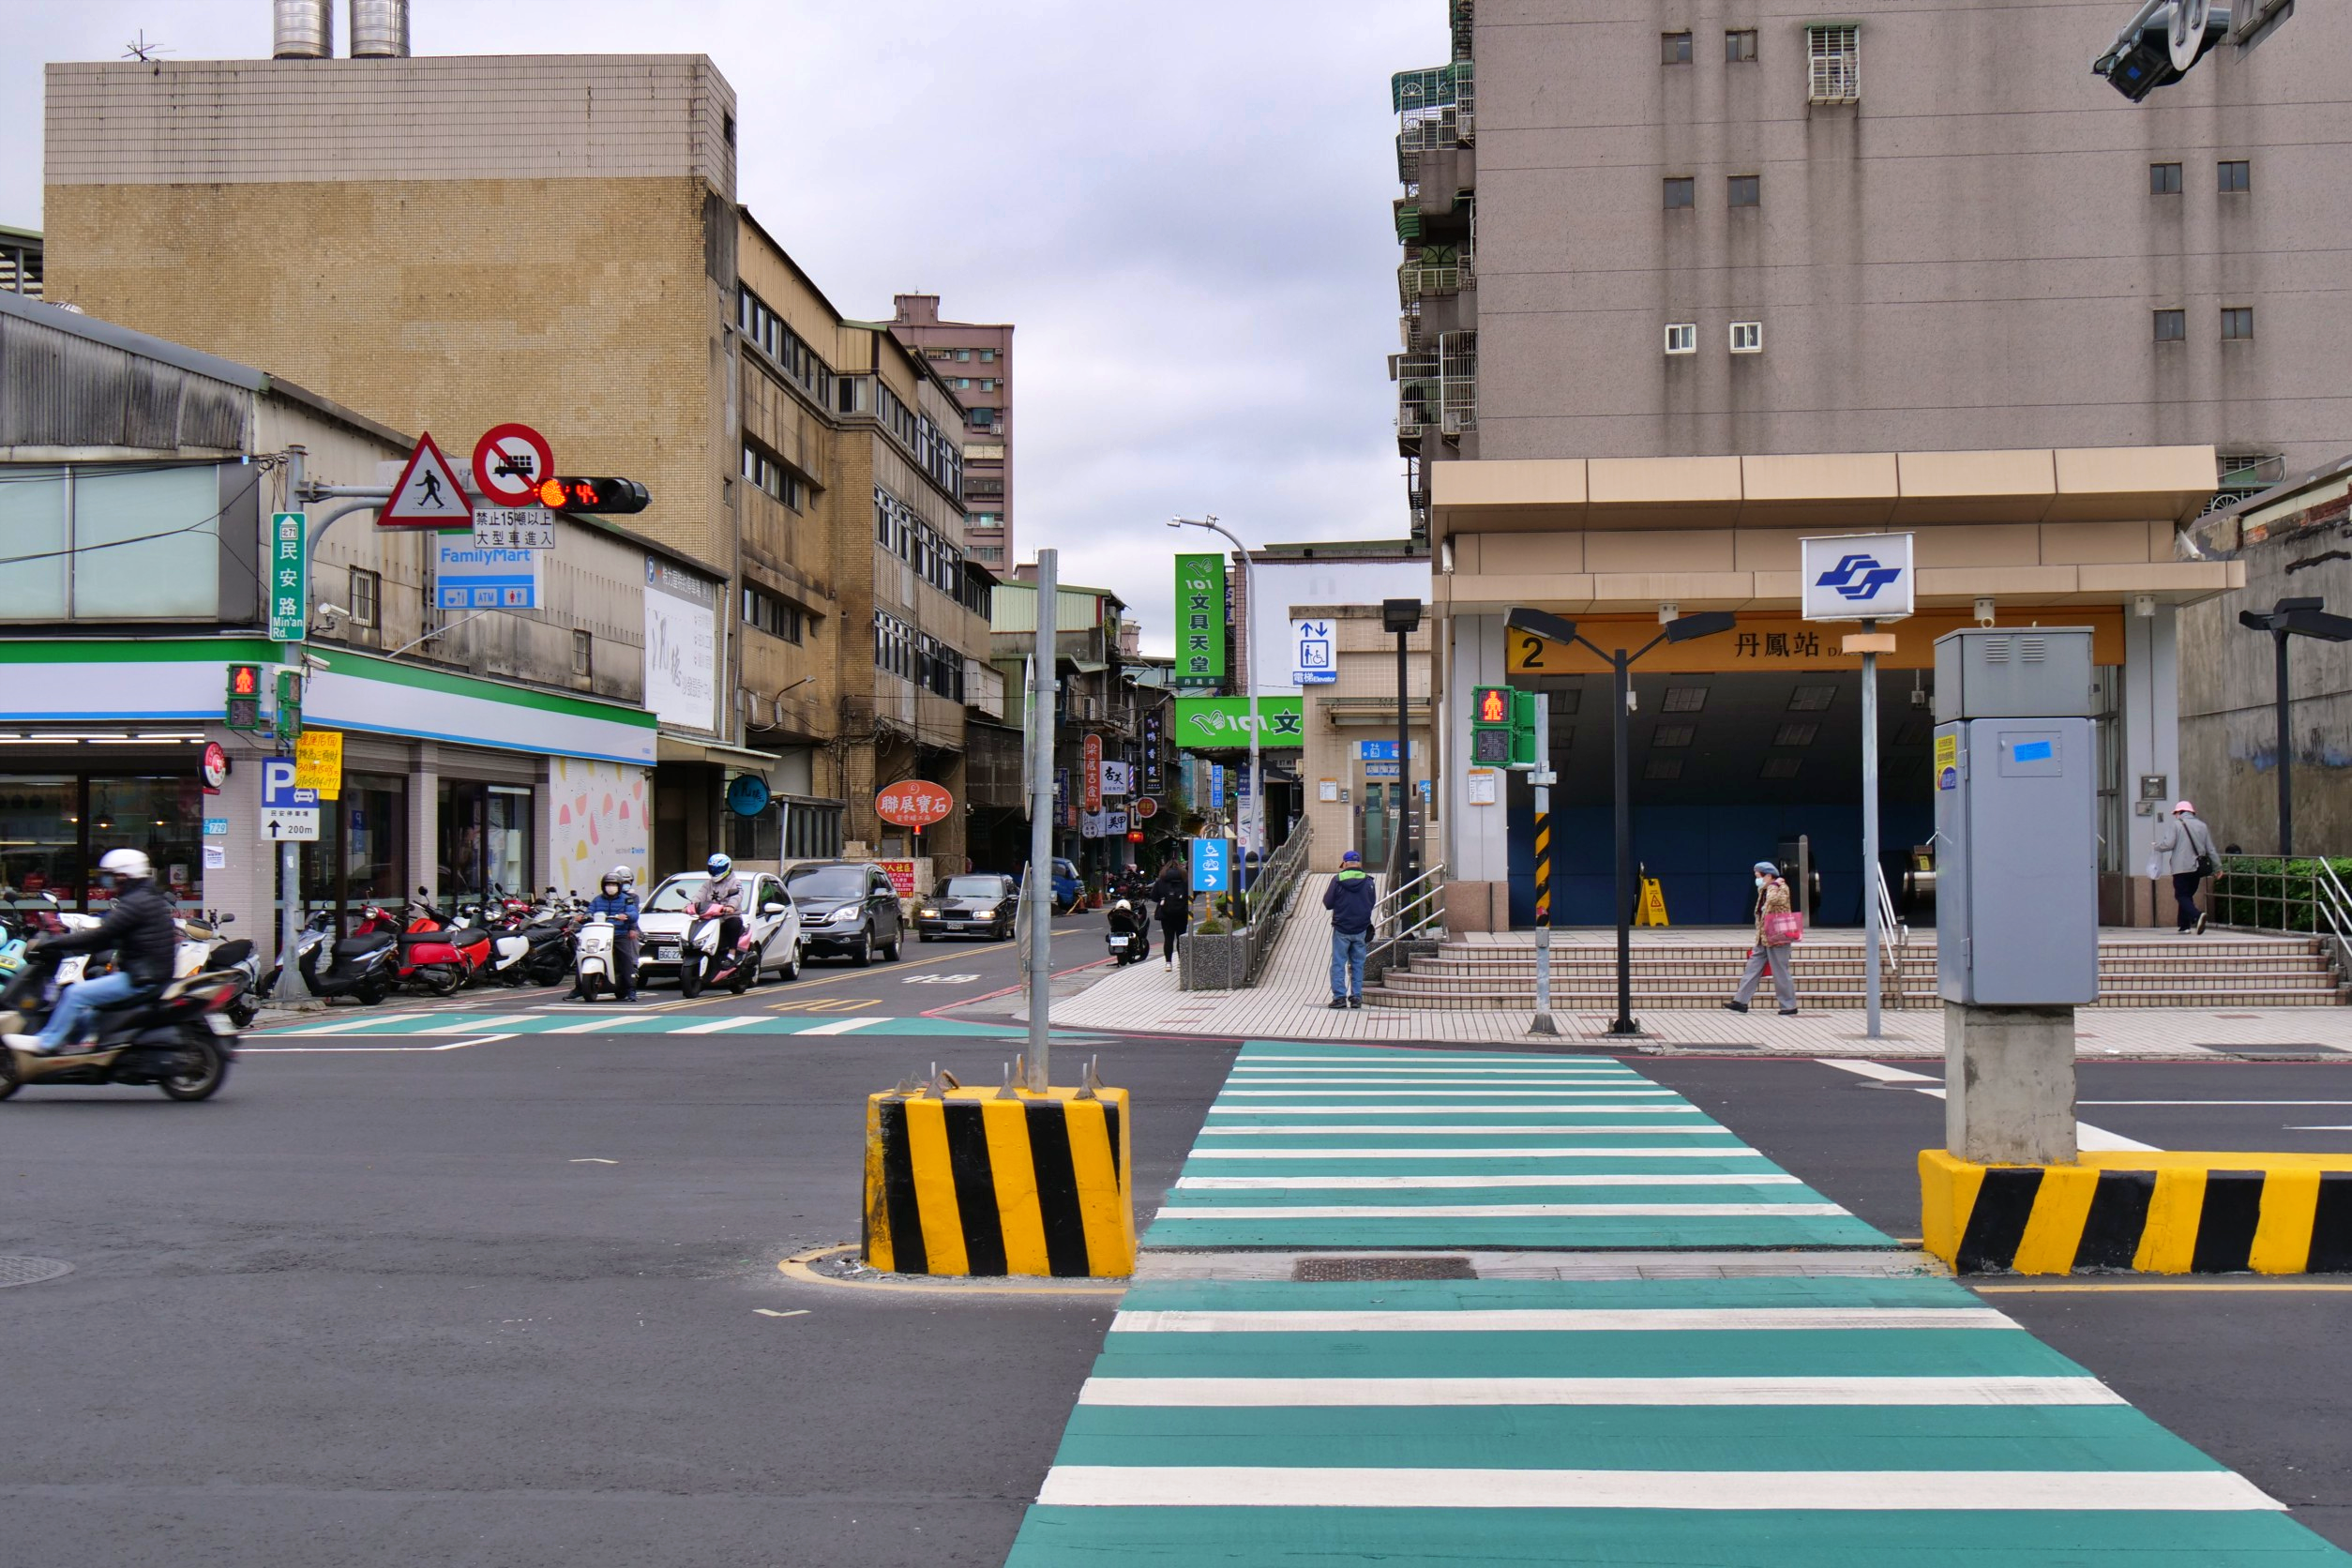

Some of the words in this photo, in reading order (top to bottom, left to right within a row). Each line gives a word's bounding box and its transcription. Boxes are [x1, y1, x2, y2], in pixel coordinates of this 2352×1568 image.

[476, 531, 552, 546] 大型車進入
[441, 548, 531, 565] FamilyMart
[279, 541, 298, 616] 民安路
[1185, 580, 1214, 590] 101
[477, 592, 494, 603] ATM
[273, 616, 303, 627] Min'an
[273, 626, 288, 639] Rd.
[1188, 592, 1211, 673] 文具天堂
[1734, 631, 1820, 658] 丹鳳站
[1522, 637, 1545, 668] 2
[1293, 671, 1314, 683] 電梯
[265, 762, 297, 803] P
[881, 794, 946, 814] 聯展寶石
[210, 823, 226, 833] 729
[288, 825, 312, 834] 200m
